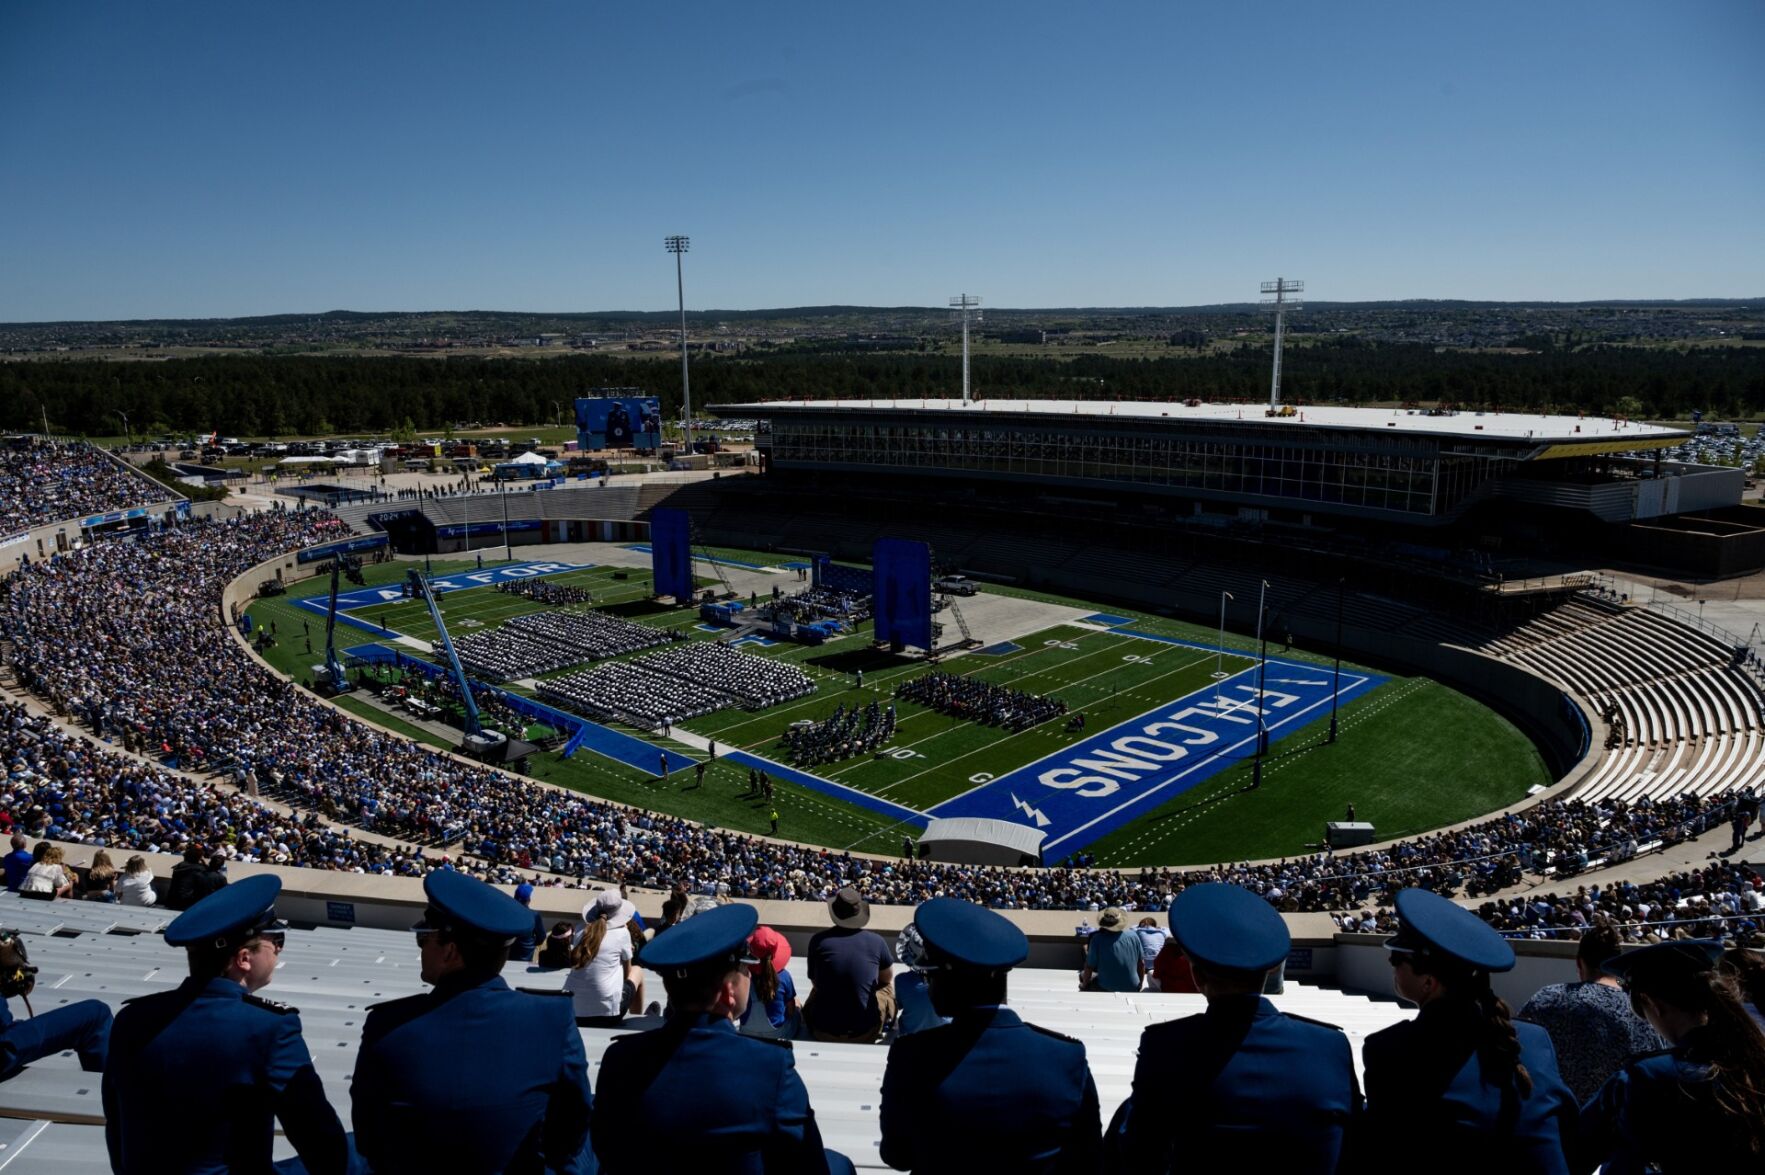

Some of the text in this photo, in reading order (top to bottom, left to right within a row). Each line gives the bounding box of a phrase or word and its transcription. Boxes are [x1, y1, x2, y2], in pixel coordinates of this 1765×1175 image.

[1038, 685, 1300, 797] FALCONS
[878, 745, 916, 760] 10
[968, 772, 994, 783] G
